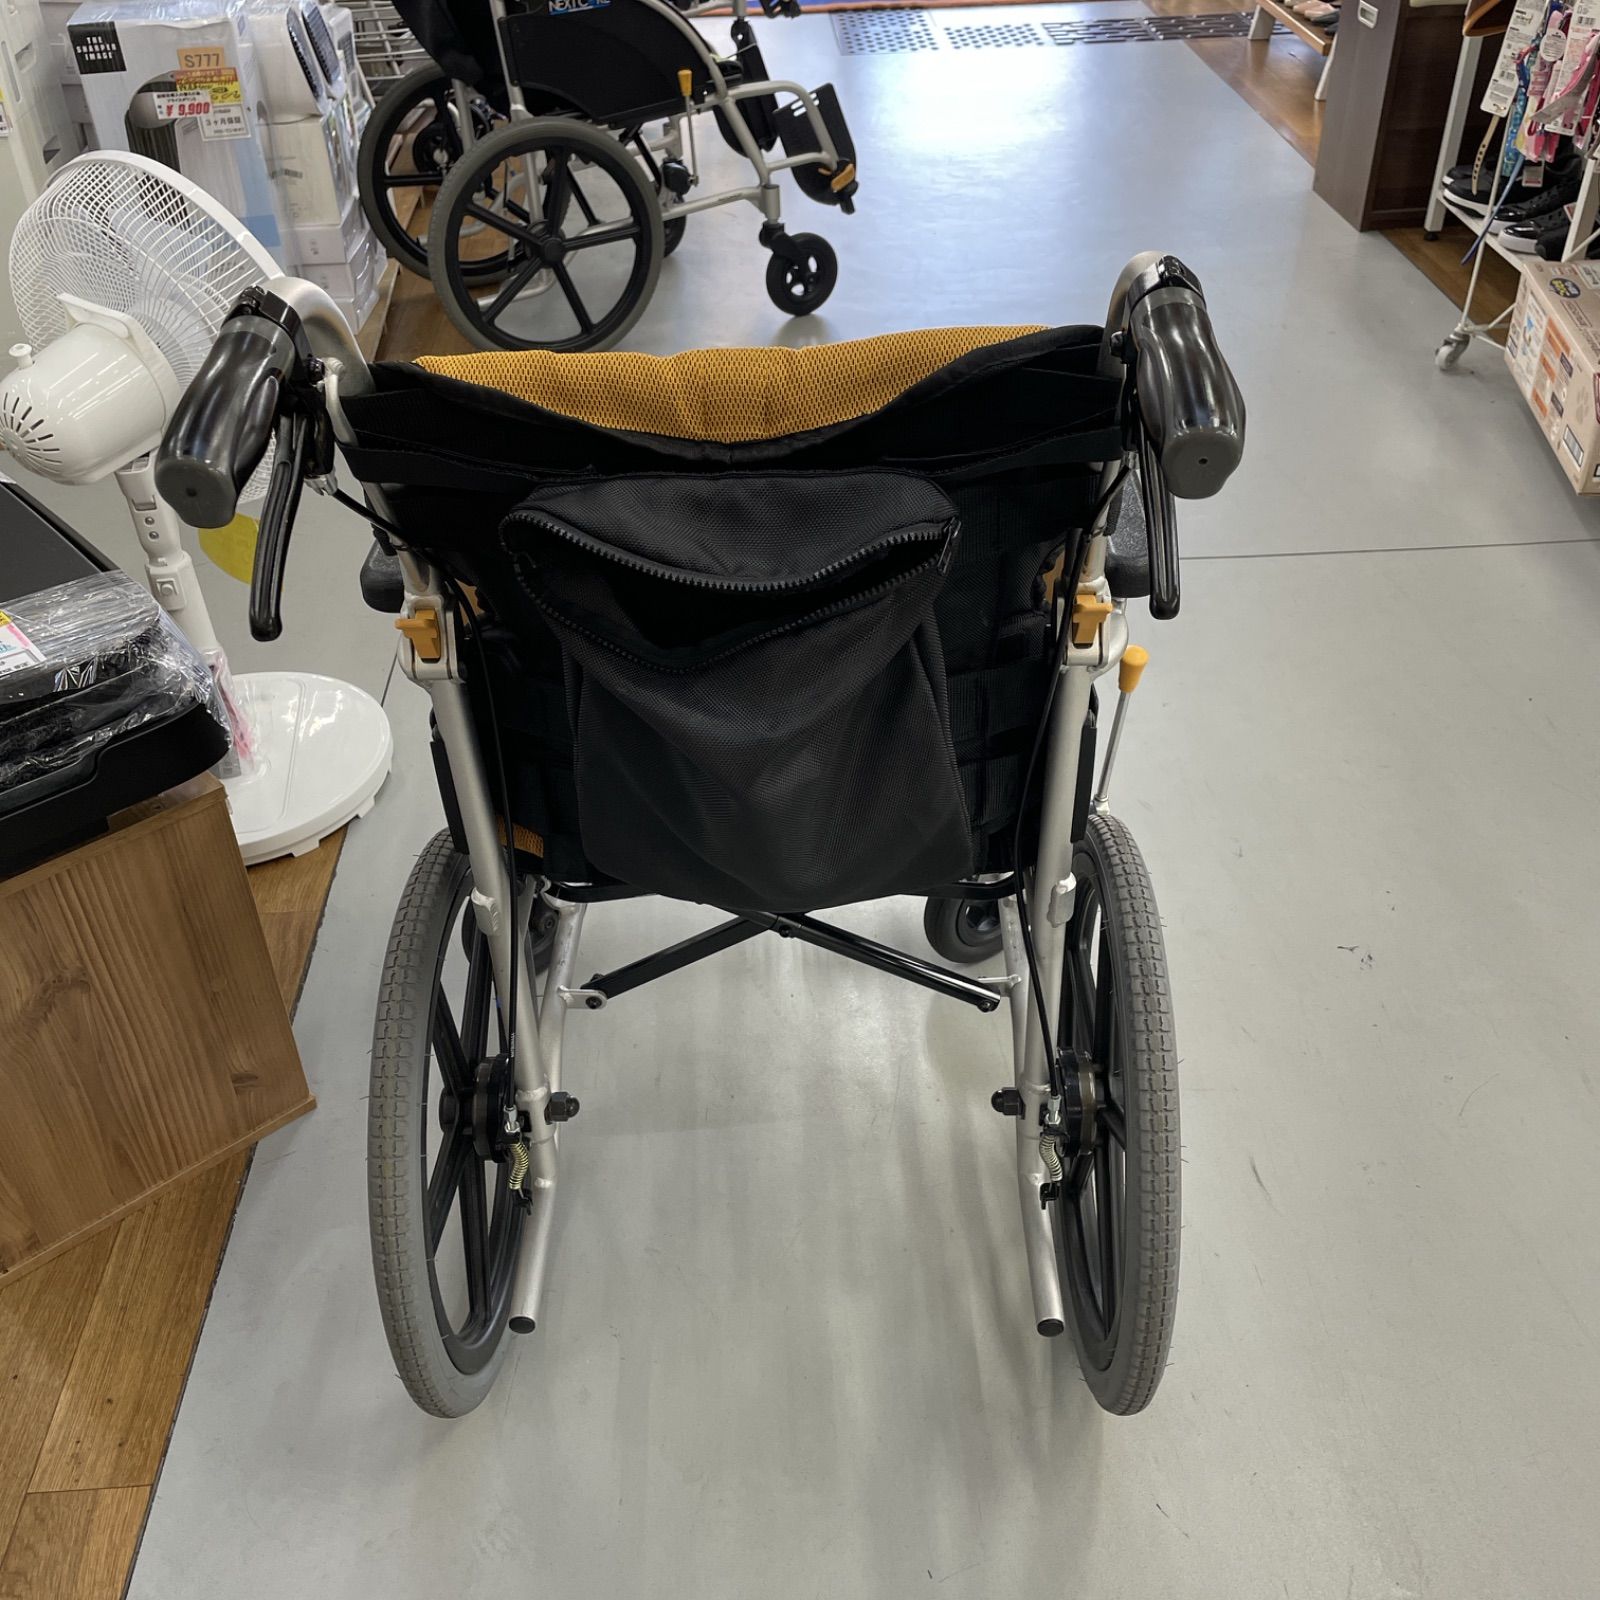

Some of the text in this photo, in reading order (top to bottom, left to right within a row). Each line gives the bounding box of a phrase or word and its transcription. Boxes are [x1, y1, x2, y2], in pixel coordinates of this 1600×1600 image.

[548, 0, 611, 12] NEXTC
[86, 36, 103, 45] THE
[76, 43, 117, 53] SHARPER
[84, 51, 113, 61] IMAGE
[184, 53, 220, 69] S777
[178, 102, 211, 117] 9,900
